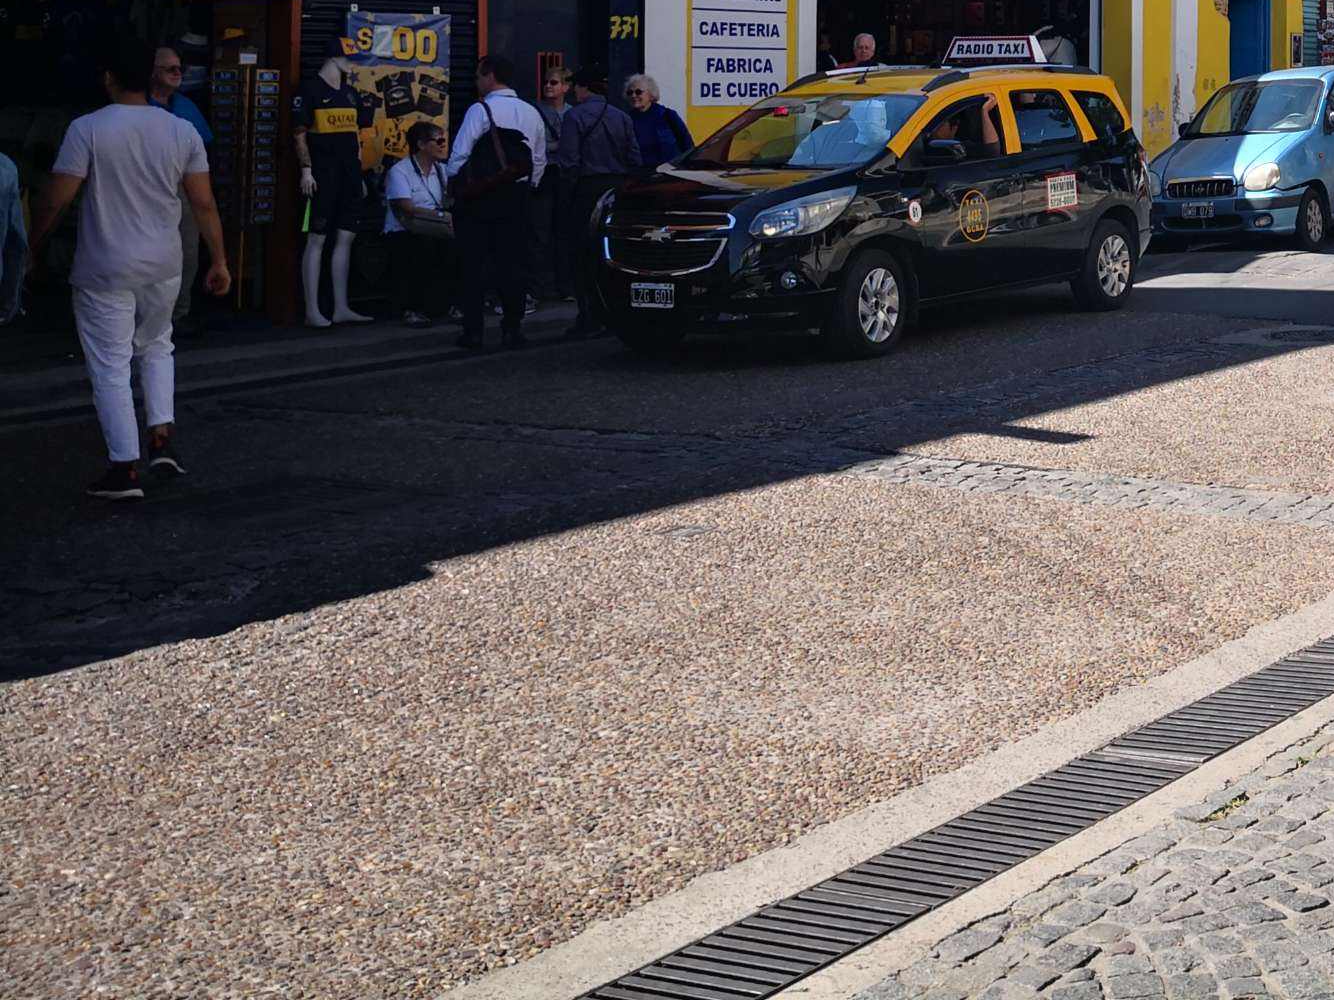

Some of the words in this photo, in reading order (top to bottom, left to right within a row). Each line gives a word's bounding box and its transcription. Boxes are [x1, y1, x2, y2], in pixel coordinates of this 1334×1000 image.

[699, 21, 780, 38] CAFETERIA
[956, 43, 994, 55] RADIO
[998, 43, 1026, 55] TAXI
[706, 58, 774, 74] FABRICA
[700, 83, 721, 98] DE
[726, 83, 779, 99] CUERO
[654, 289, 672, 303] 601
